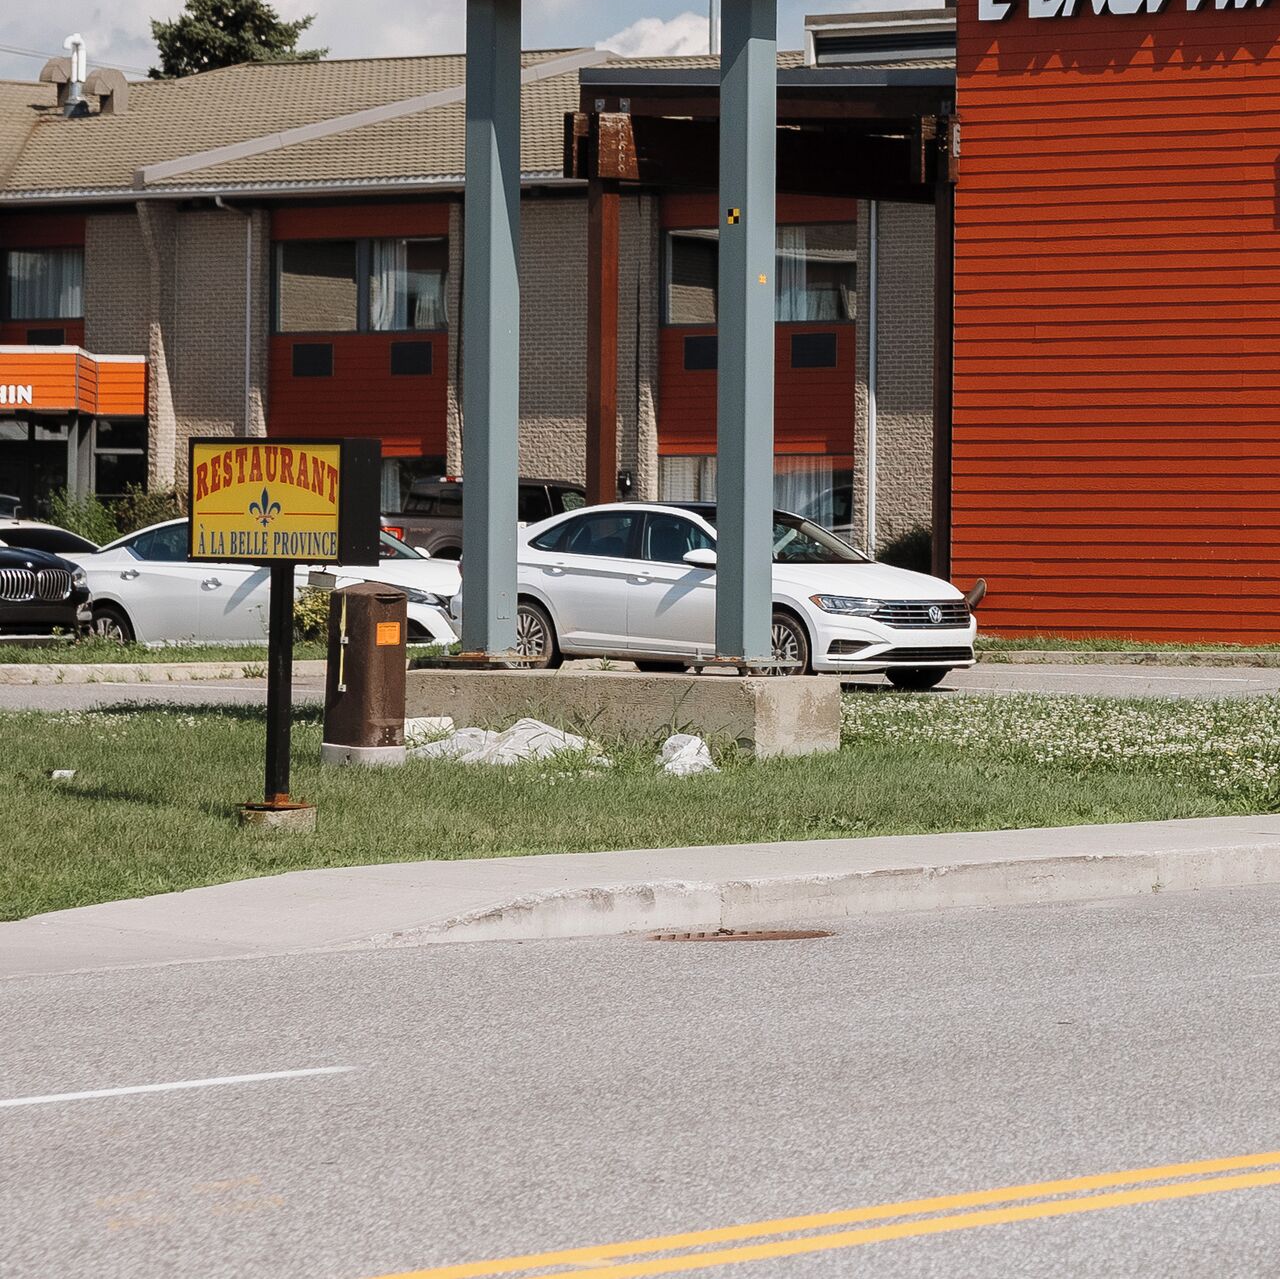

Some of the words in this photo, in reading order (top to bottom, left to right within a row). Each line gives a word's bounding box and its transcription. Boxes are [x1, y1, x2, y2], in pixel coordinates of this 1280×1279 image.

[196, 446, 338, 504] RESTAURANT
[198, 523, 206, 554] À
[210, 531, 225, 554] LA
[230, 531, 269, 555] BELLE
[273, 531, 337, 556] PROVINCE
